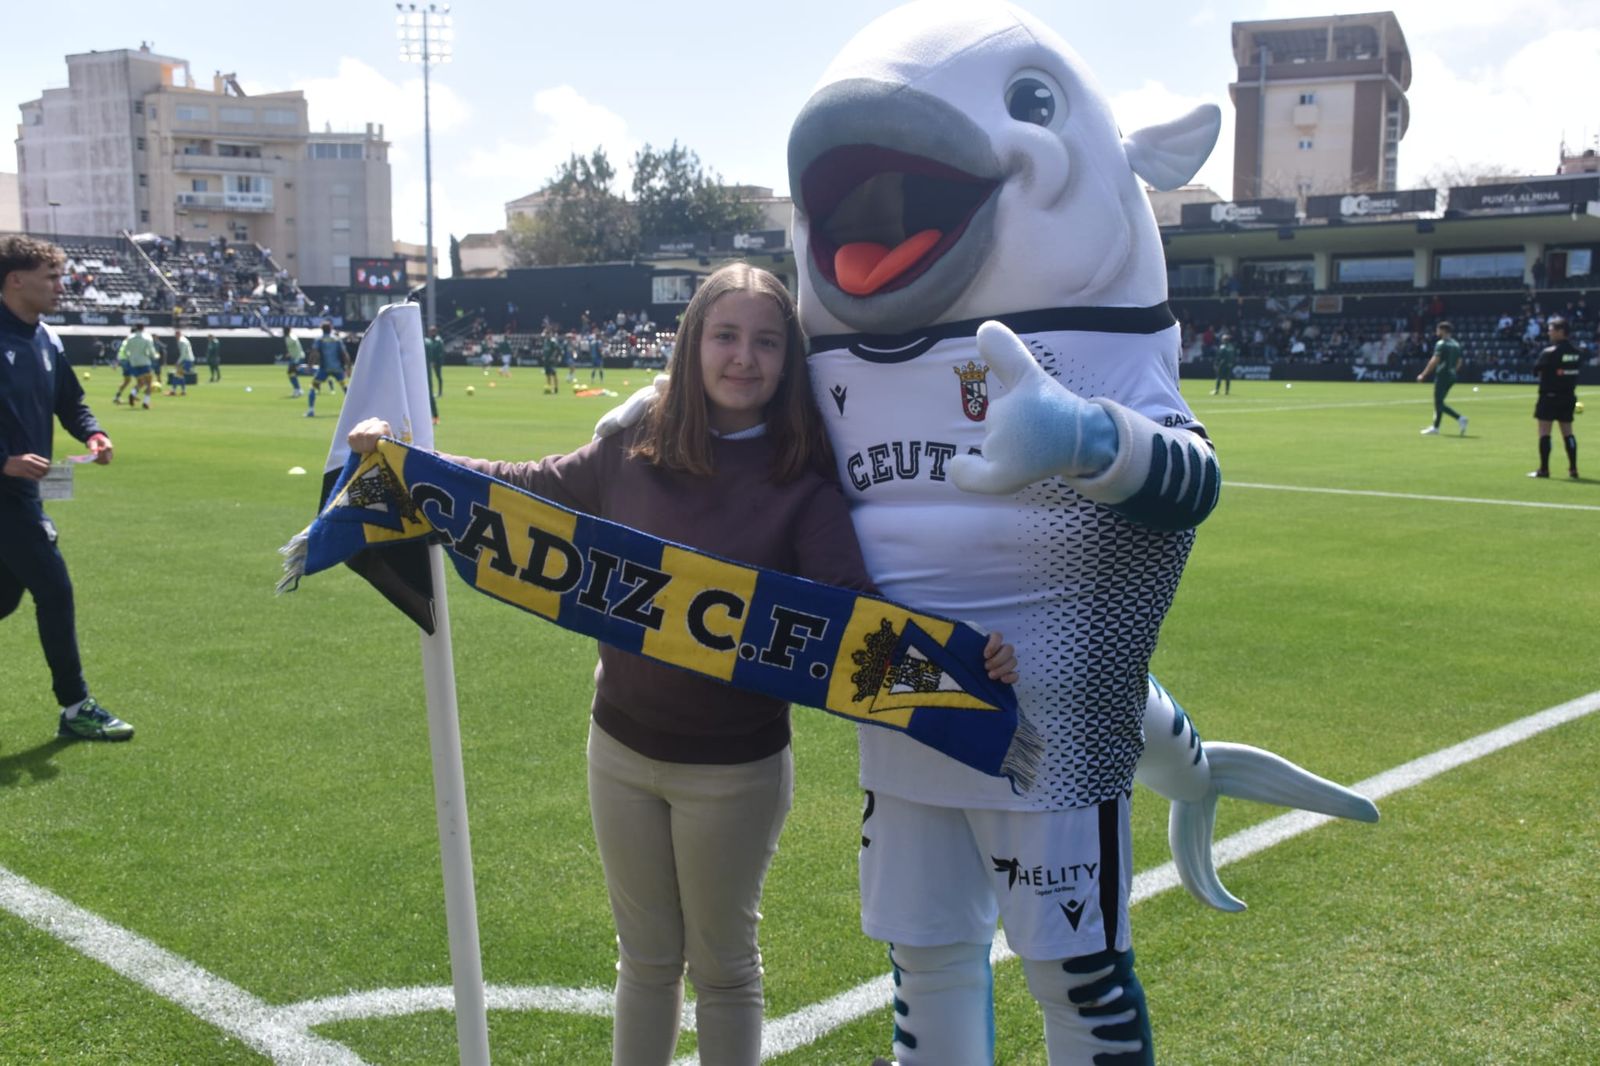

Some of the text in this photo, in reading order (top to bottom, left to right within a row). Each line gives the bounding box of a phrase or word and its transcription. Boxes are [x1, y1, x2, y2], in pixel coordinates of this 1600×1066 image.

[848, 440, 983, 492] CEUT
[411, 482, 830, 680] CADIZ C.F.
[1018, 862, 1098, 886] HÉLITY
